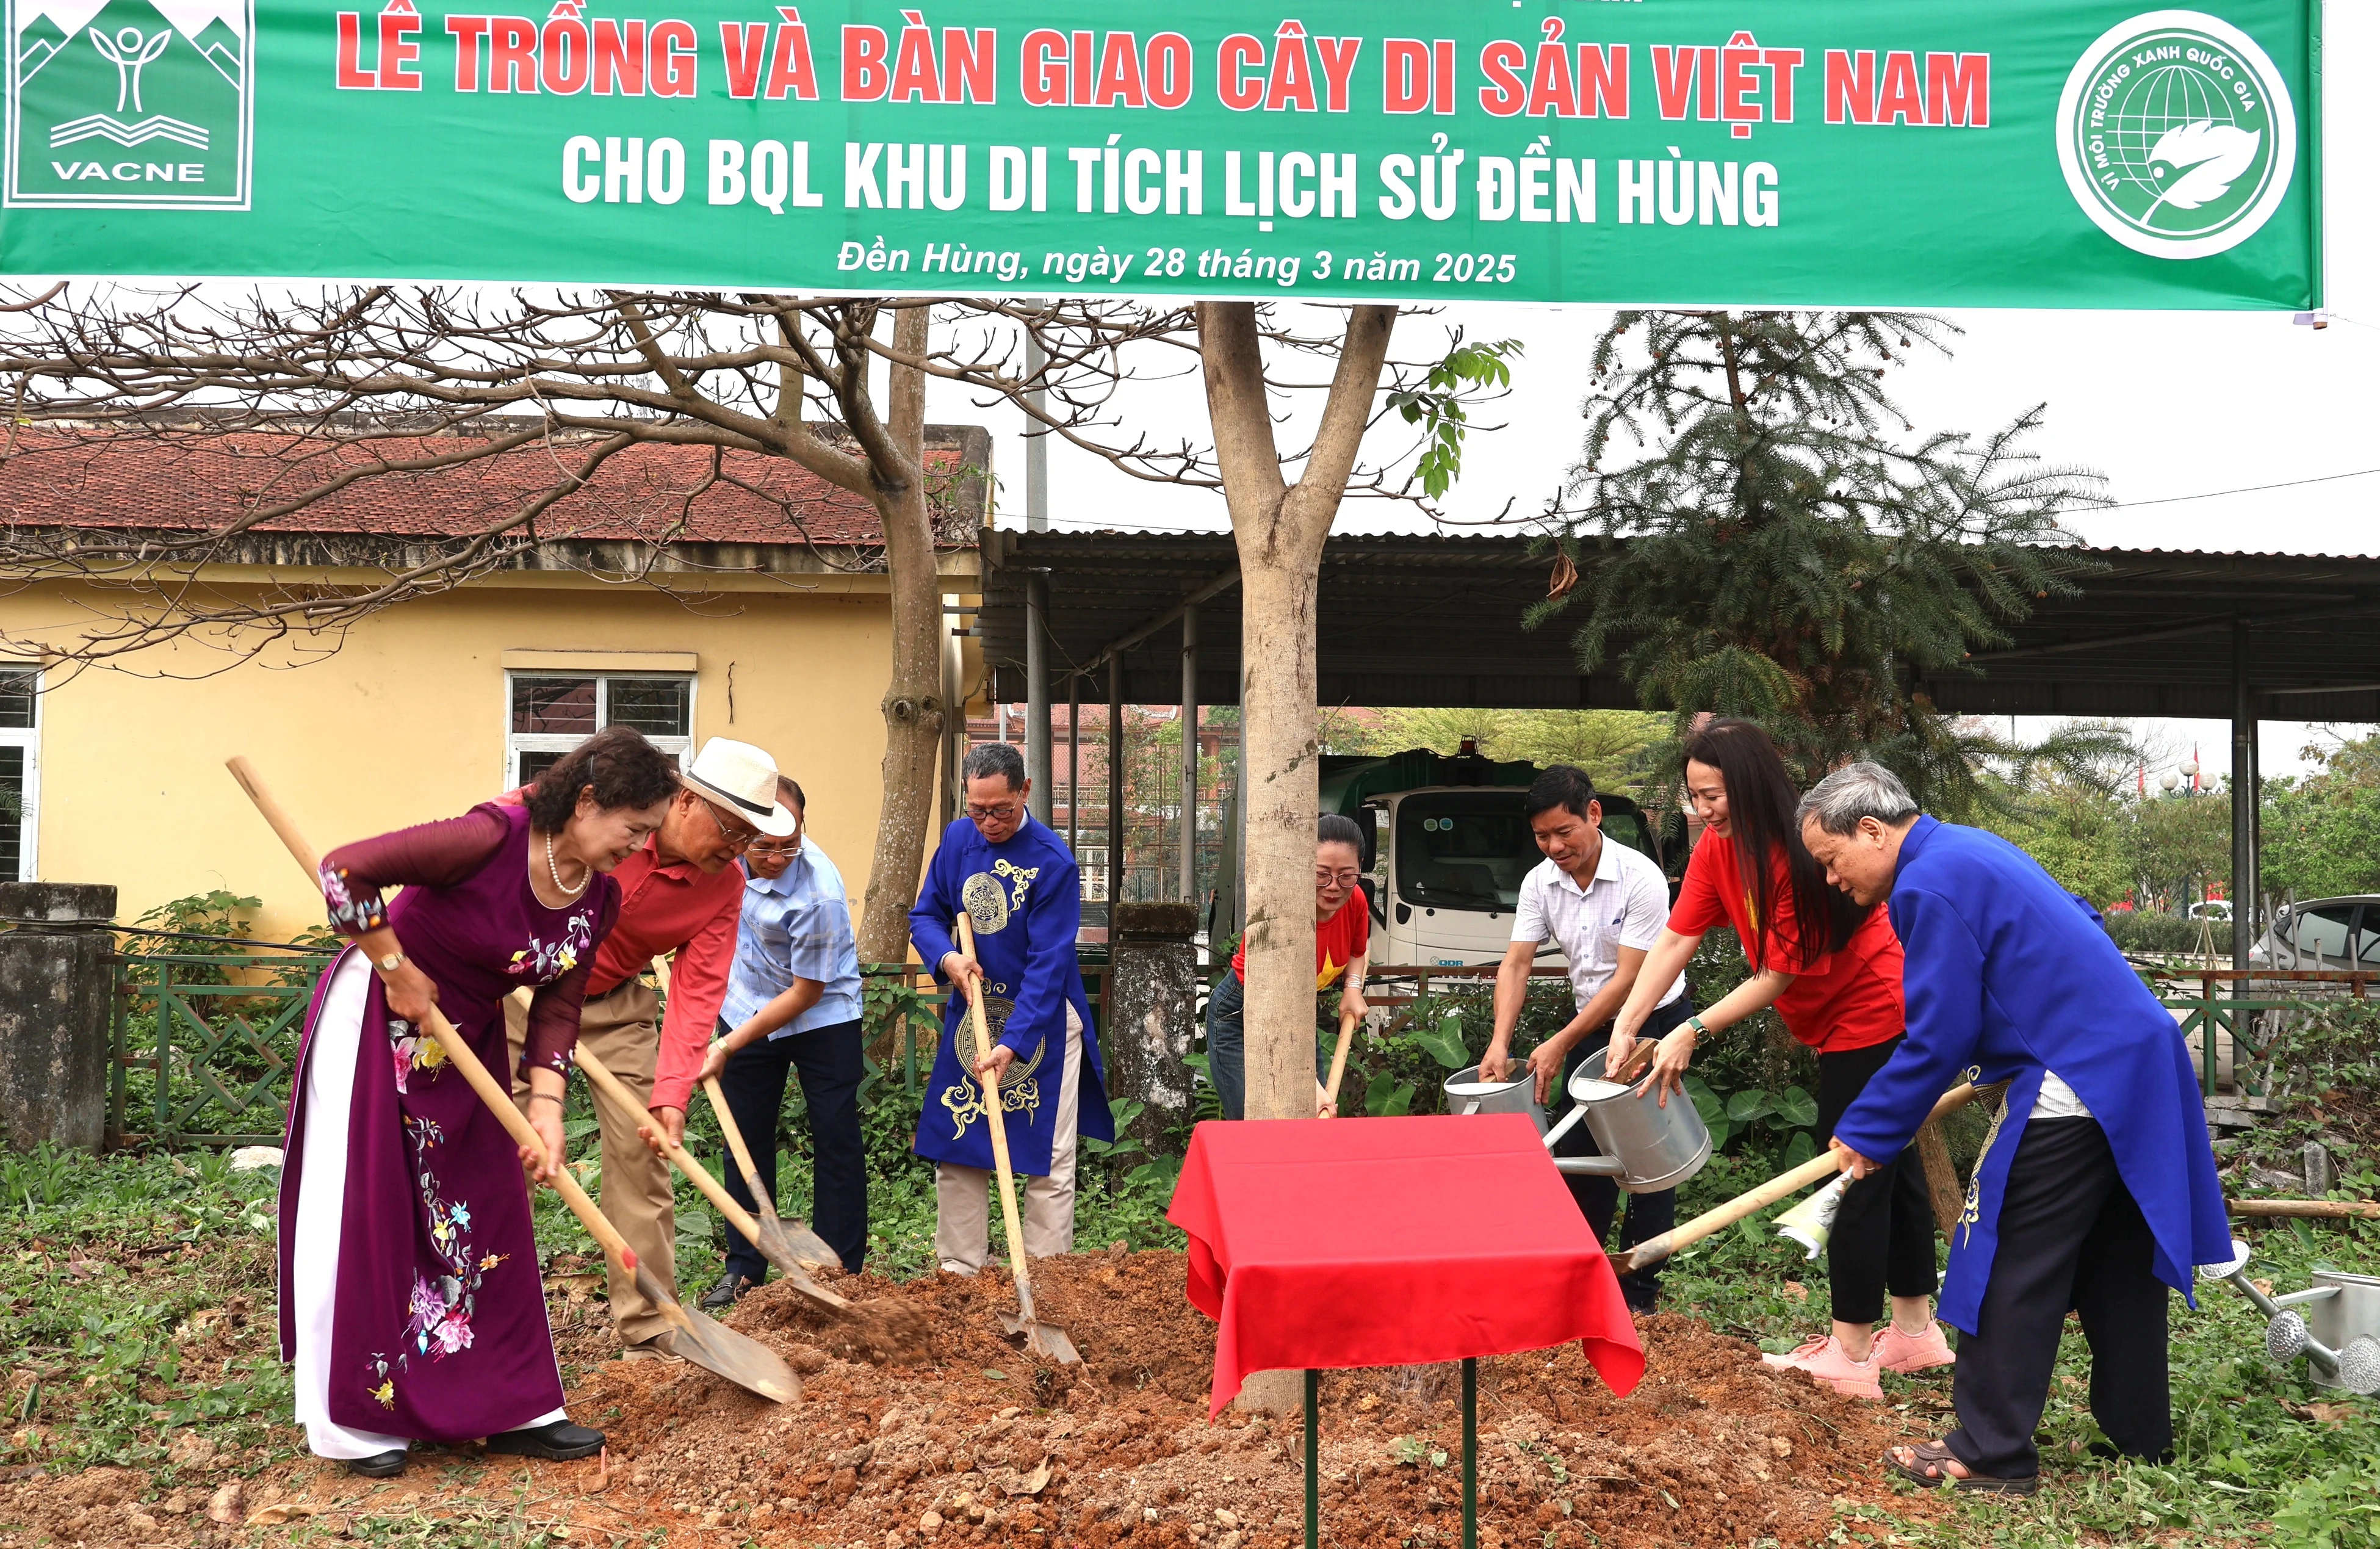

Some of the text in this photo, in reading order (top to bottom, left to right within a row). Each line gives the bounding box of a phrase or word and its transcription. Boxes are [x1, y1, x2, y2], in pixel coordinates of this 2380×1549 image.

[444, 0, 698, 99] TRỒNG
[718, 5, 820, 101] VÀ
[840, 9, 997, 106] BÀN
[1020, 28, 1193, 110] GIAO
[1216, 19, 1363, 113] CÂY
[1383, 38, 1455, 115] DI
[1478, 16, 1630, 120] SẢN
[1650, 31, 1805, 139] VIỆT
[1824, 49, 1990, 128] NAM
[2088, 46, 2256, 191] VÌ MÔI TRƯỜNG XANH QUỐC GIA
[51, 161, 205, 182] VACNE
[562, 132, 1779, 232] CHO BQL KHU DI TÍCH LỊCH SỬ ĐỀN HÙNG
[837, 235, 1516, 287] Đền Hùng, ngày 28 tháng 3 năm 2025
